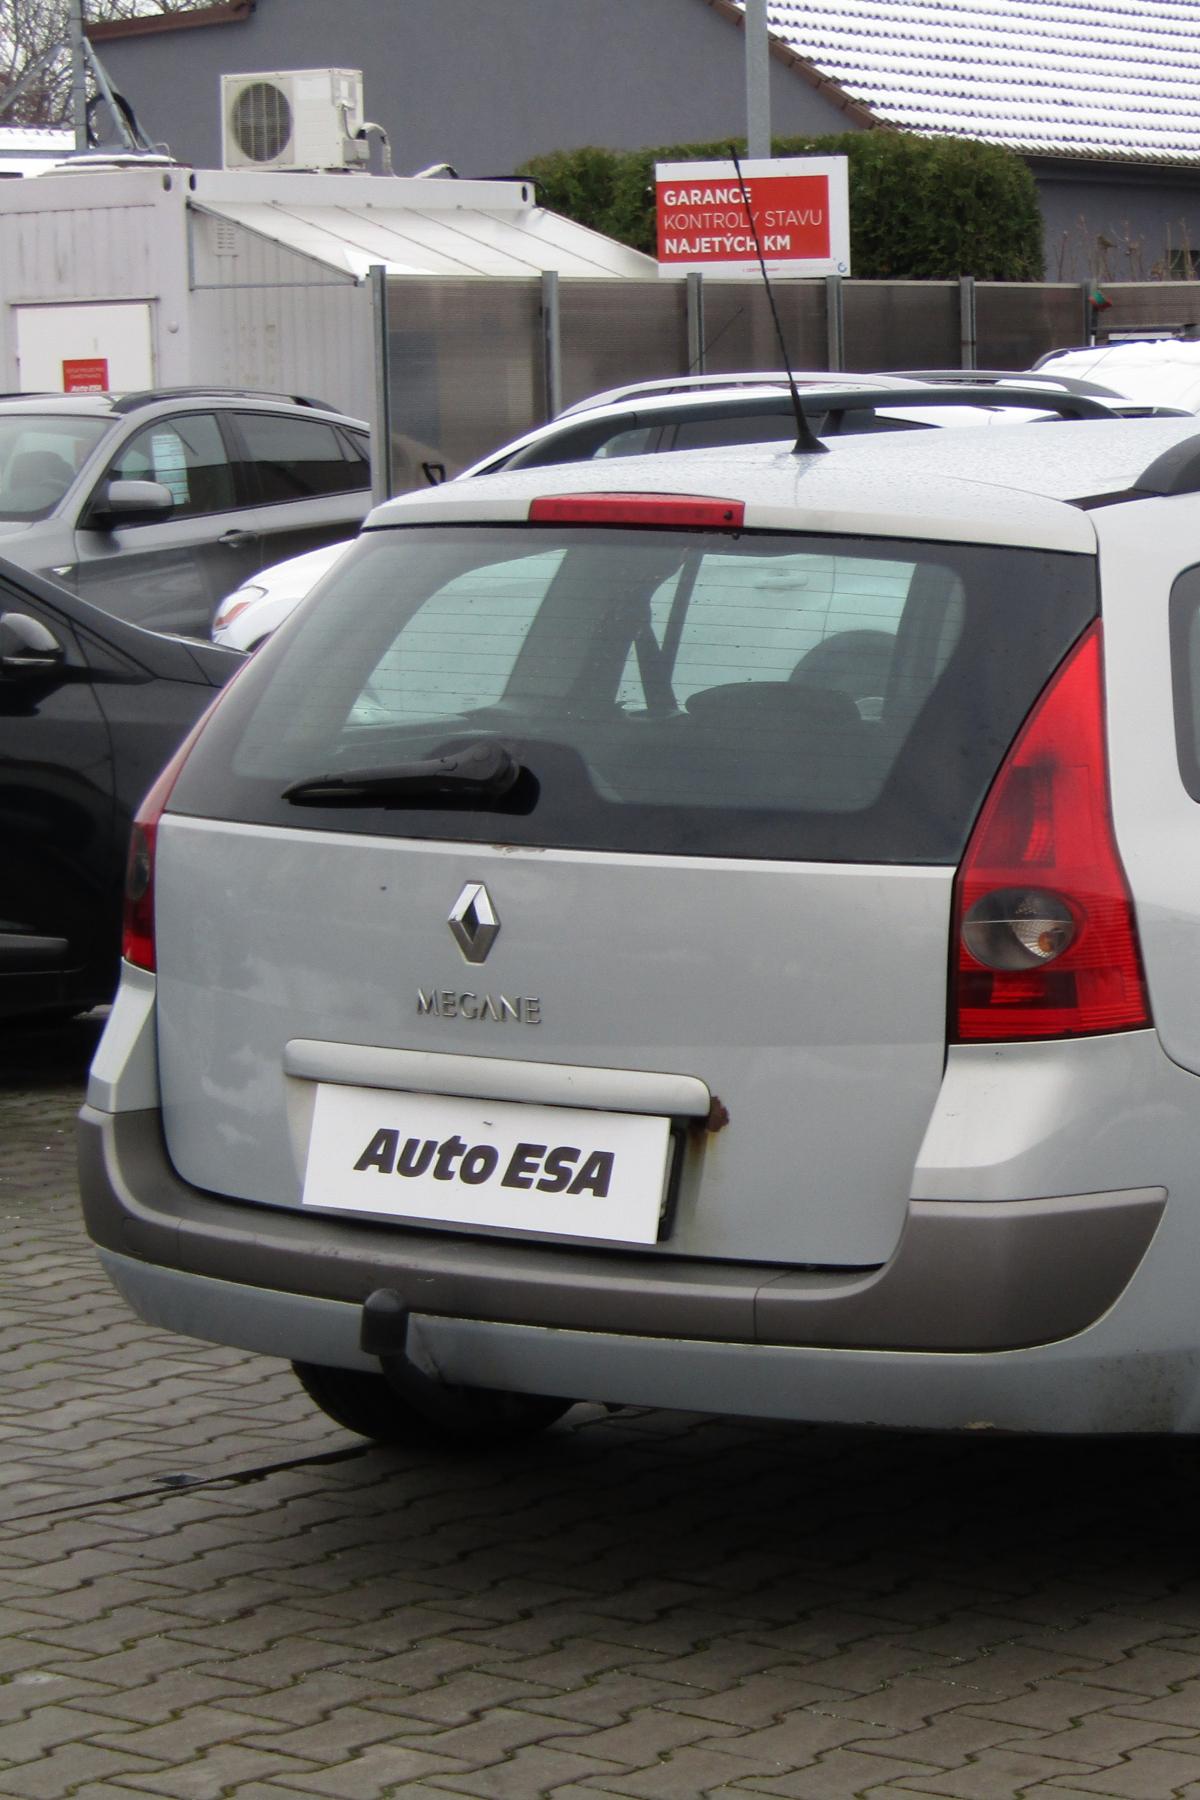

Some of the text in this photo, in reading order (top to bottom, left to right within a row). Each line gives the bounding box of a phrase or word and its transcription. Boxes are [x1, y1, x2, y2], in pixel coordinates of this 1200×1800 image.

[664, 187, 752, 206] GARANCE
[664, 209, 823, 230] KONTROLY STAVU
[664, 233, 791, 254] NAJETÝCH KM
[416, 988, 542, 1024] MEGANE
[353, 1128, 616, 1198] Auto ESA
